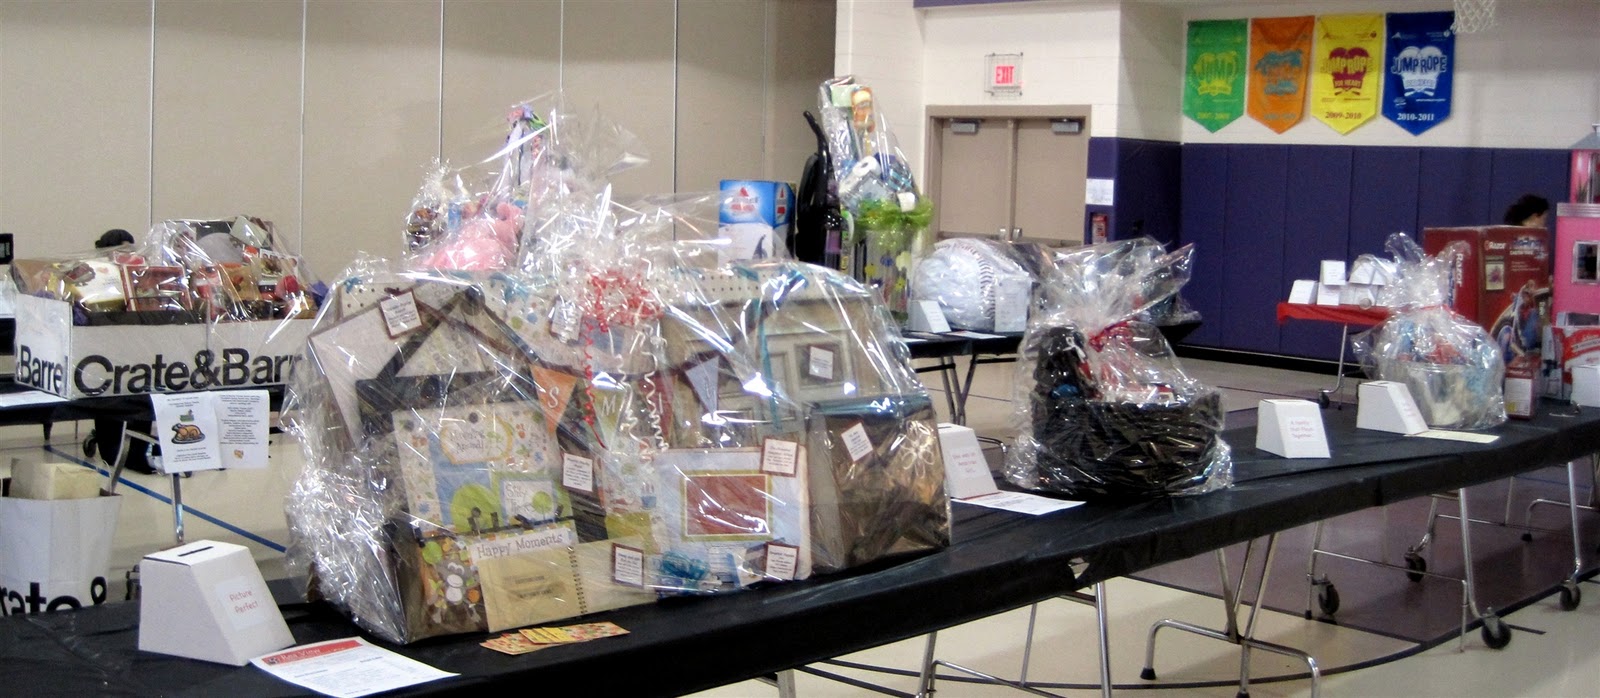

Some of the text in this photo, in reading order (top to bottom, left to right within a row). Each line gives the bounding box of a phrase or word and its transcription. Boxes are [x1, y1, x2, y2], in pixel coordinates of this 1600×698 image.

[996, 65, 1014, 84] EXIT
[1391, 55, 1447, 75] JUMP ROPE
[1397, 113, 1435, 121] 2010-2011
[17, 344, 69, 396] Barrel
[477, 533, 563, 558] Happy Moments
[229, 590, 253, 601] Picture
[234, 600, 259, 614] Perfect
